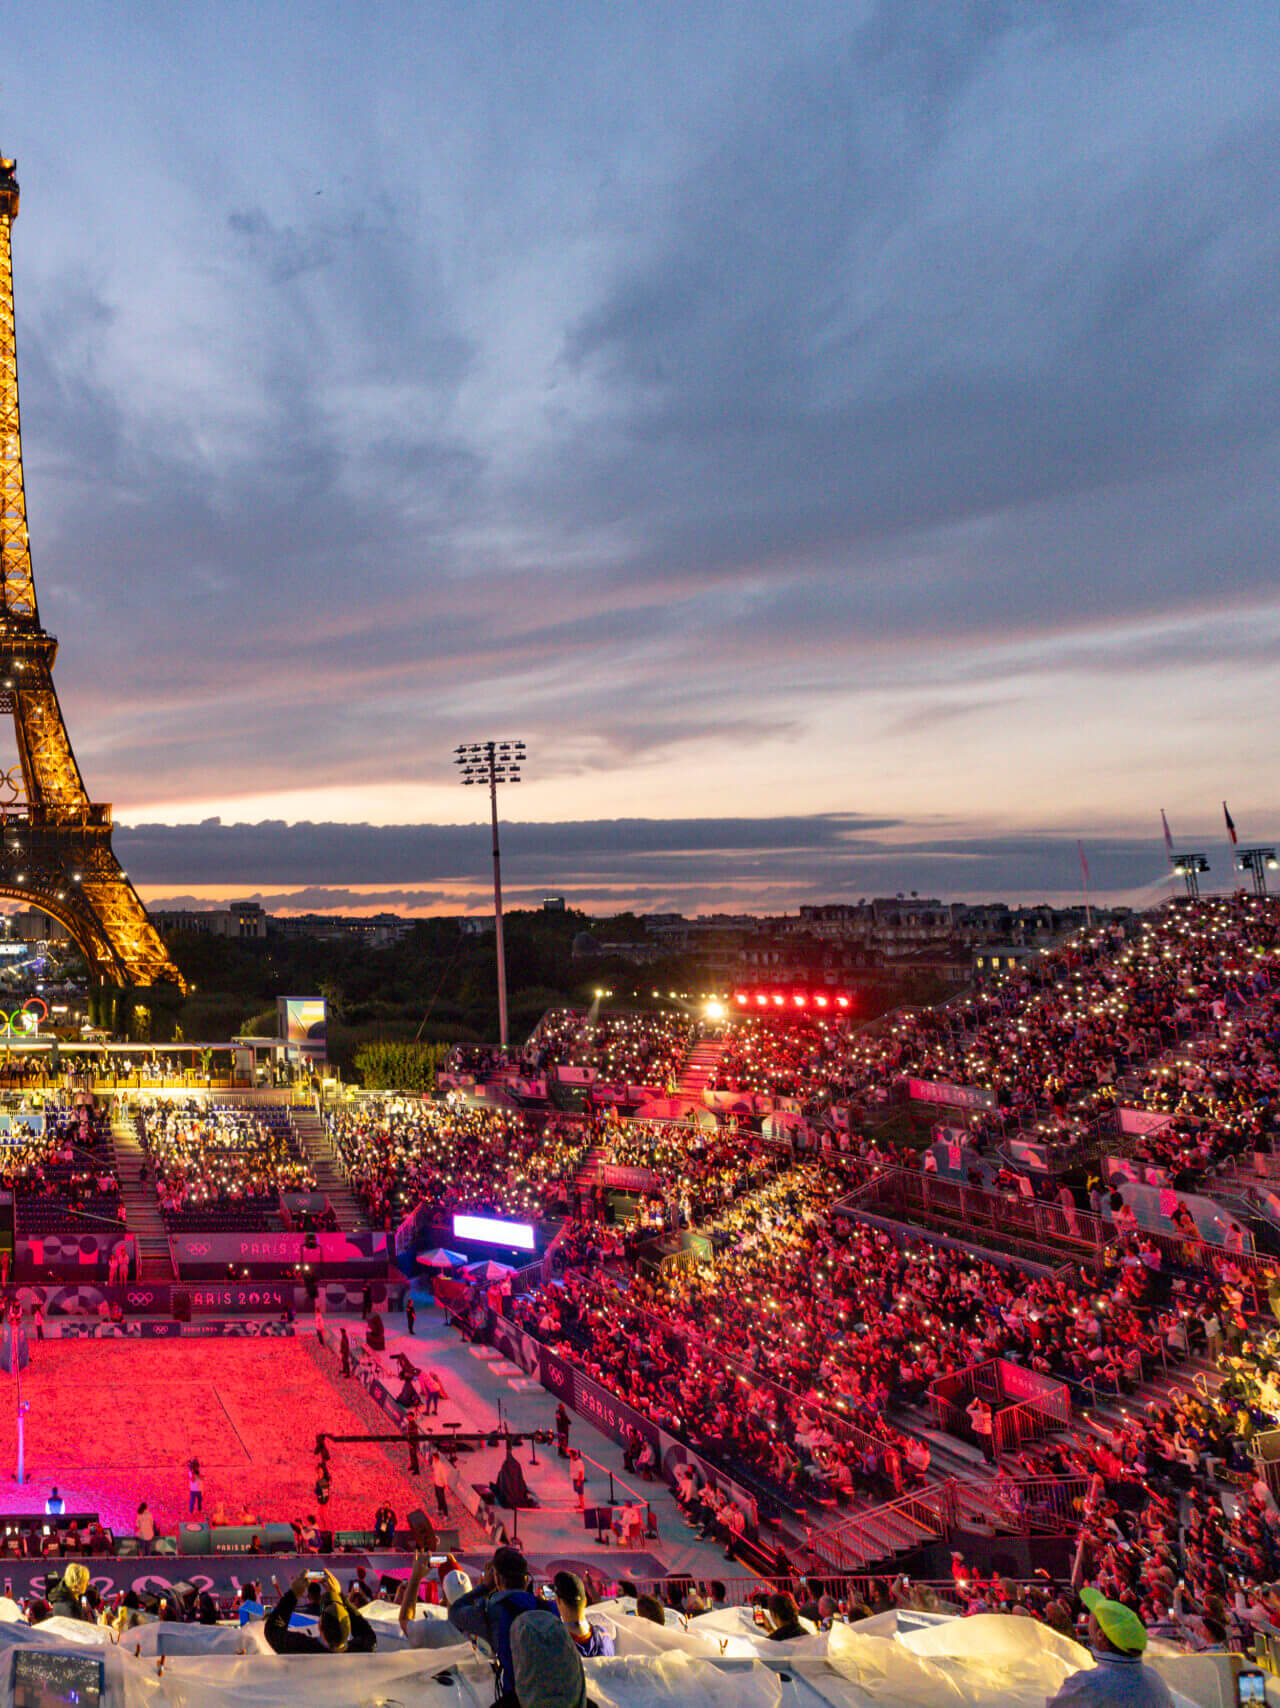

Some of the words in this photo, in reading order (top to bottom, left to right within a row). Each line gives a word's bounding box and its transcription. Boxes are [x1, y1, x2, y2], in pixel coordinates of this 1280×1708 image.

[239, 1242, 287, 1255] PARIS
[188, 1292, 232, 1305] ARIS
[238, 1292, 282, 1305] 2024
[582, 1389, 615, 1427] PARIS
[216, 1543, 239, 1552] PARIS
